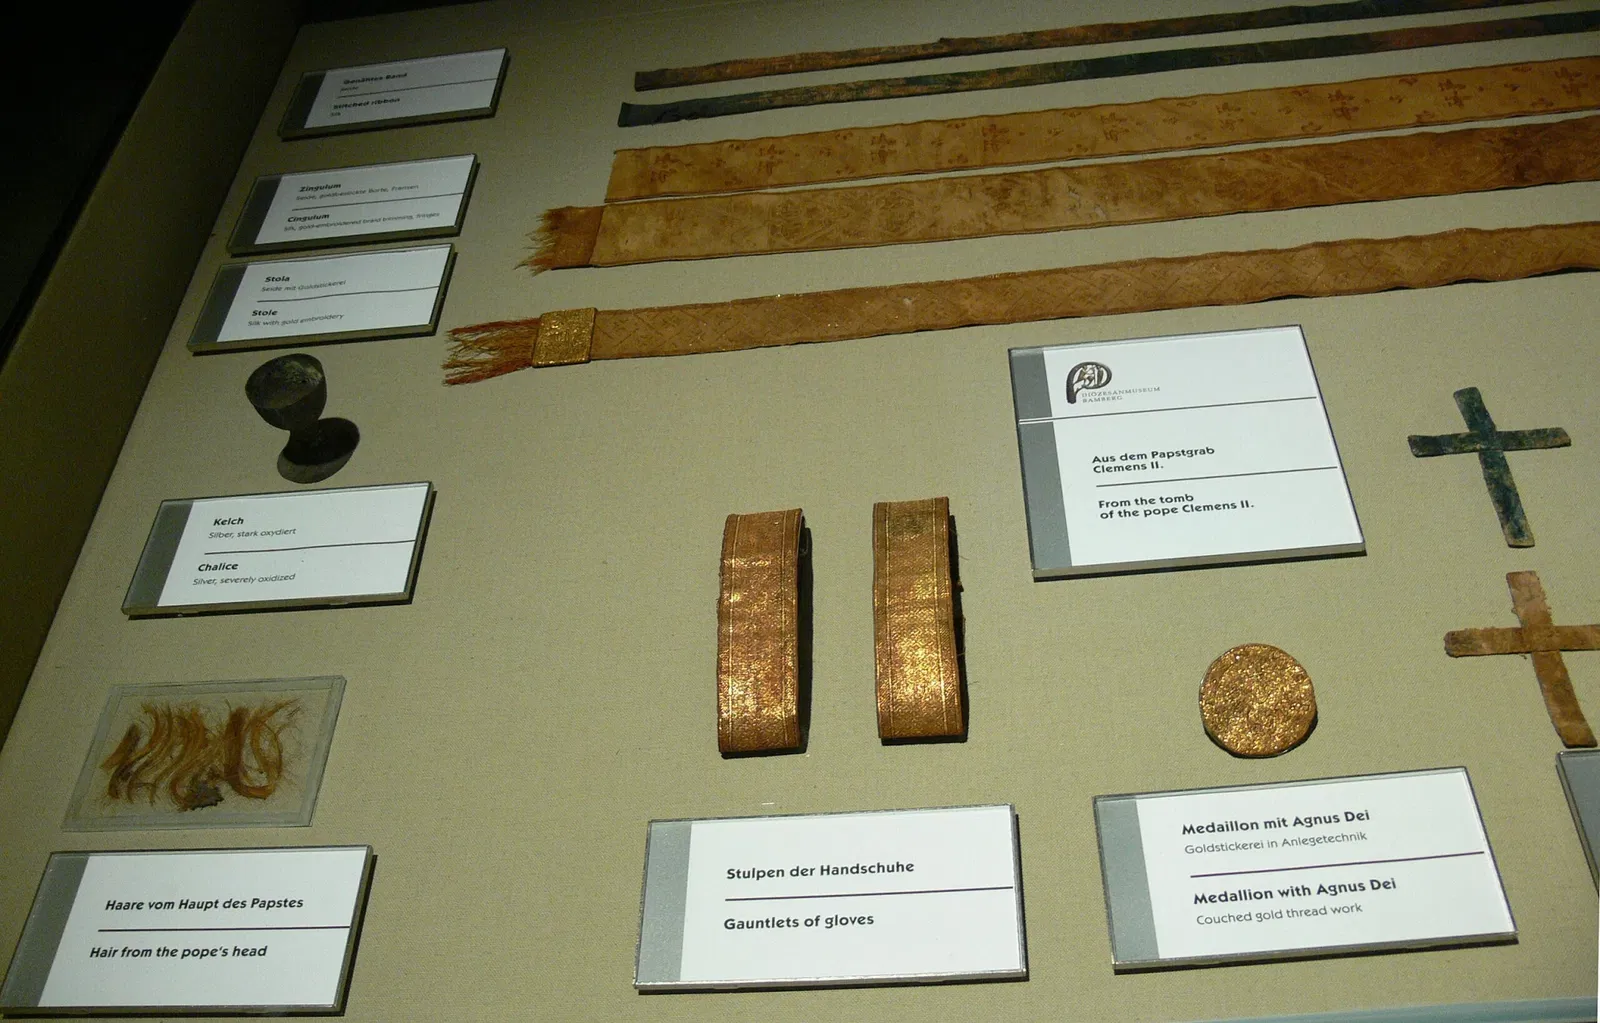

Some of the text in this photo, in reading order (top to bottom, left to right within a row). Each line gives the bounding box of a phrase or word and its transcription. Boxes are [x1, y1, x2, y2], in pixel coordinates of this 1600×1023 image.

[334, 101, 369, 109] Stitched
[299, 183, 341, 192] Zingulum
[288, 213, 330, 222] Cingulum
[298, 280, 346, 290] Goldstickerei
[300, 314, 344, 323] embroidery
[1082, 387, 1160, 397] DIÖZESANMUSEUM
[1120, 453, 1147, 461] dem
[1151, 447, 1215, 459] Papstgrab
[1093, 461, 1163, 473] Clemens II.
[1099, 494, 1194, 508] From the tomb
[1100, 500, 1254, 519] of the pope Clemens II.
[214, 517, 244, 526] Kelch
[260, 529, 296, 537] oxydiert
[198, 562, 239, 571] Chalice
[220, 576, 256, 584] severely
[258, 574, 296, 582] oxidized
[1182, 810, 1370, 835] Medaillon mit Agnus Dei
[1184, 831, 1368, 854] Goldstickerei in Anlegetechnik
[727, 861, 914, 880] Stulpen der Handschuhe
[1194, 878, 1396, 904] Medallion with Agnus Dei
[105, 898, 304, 911] Haare vom Haupt des Papstes
[1196, 903, 1363, 925] Couched gold thread work
[724, 914, 874, 930] Gauntlets of gloves
[90, 946, 268, 959] Hair from the pope's head
